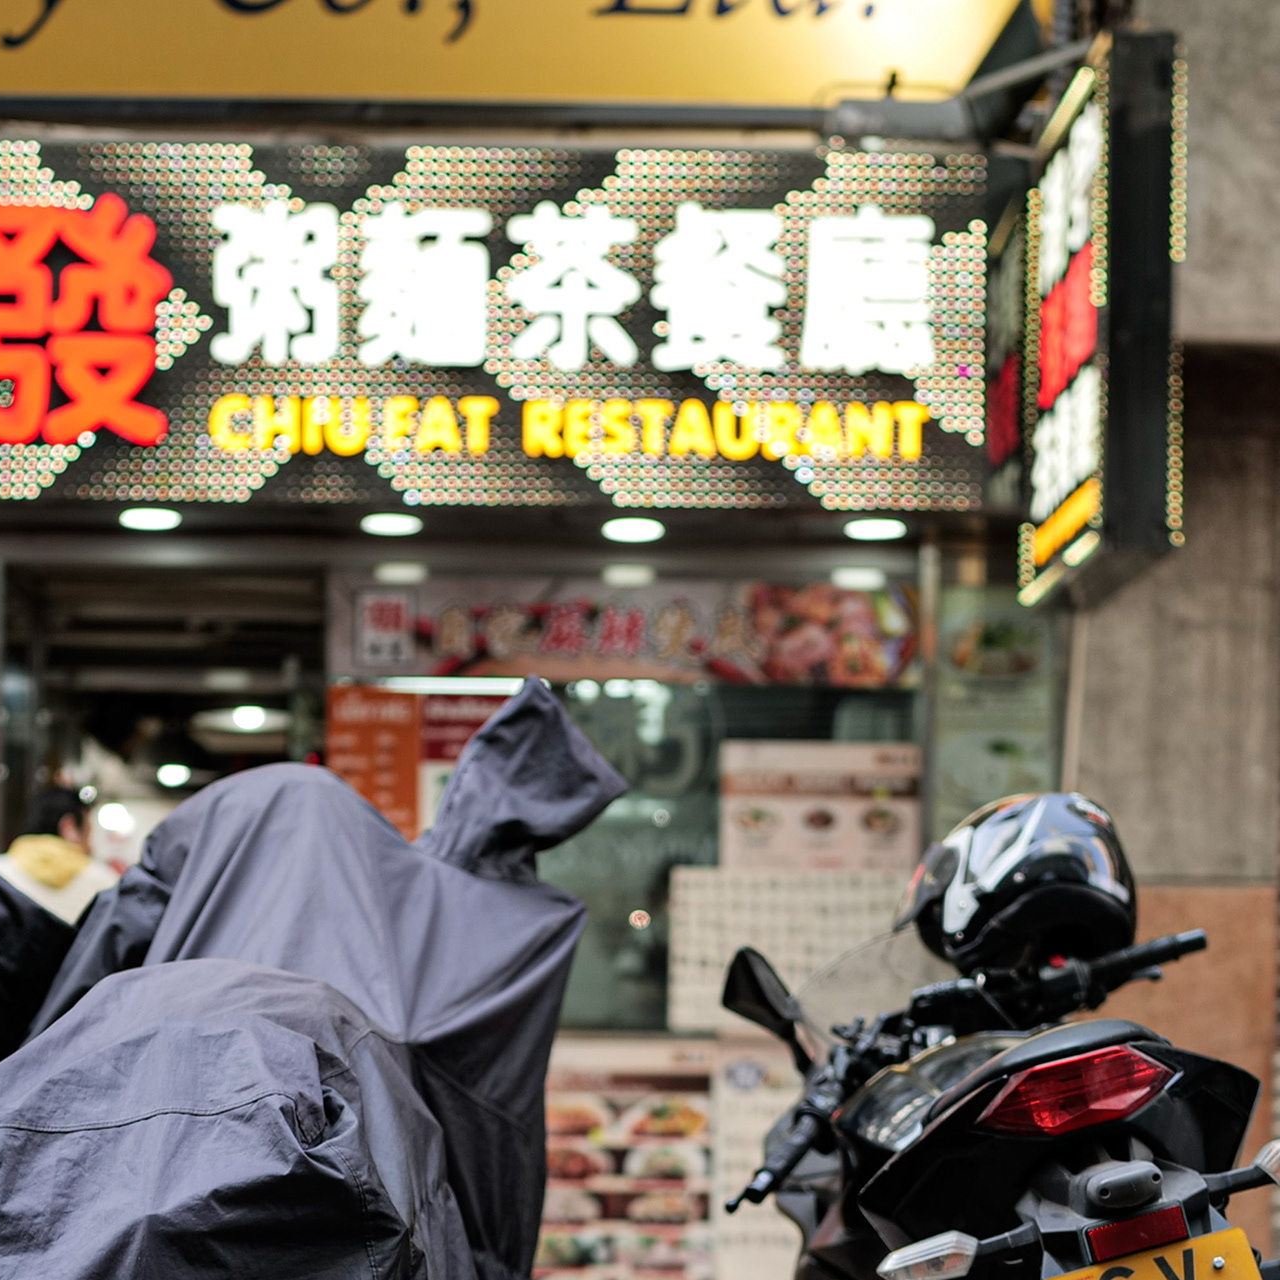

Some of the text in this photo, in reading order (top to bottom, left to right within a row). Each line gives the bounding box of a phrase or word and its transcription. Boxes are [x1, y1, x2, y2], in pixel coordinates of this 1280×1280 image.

[208, 393, 932, 462] CHIU FAT RESTAURANT
